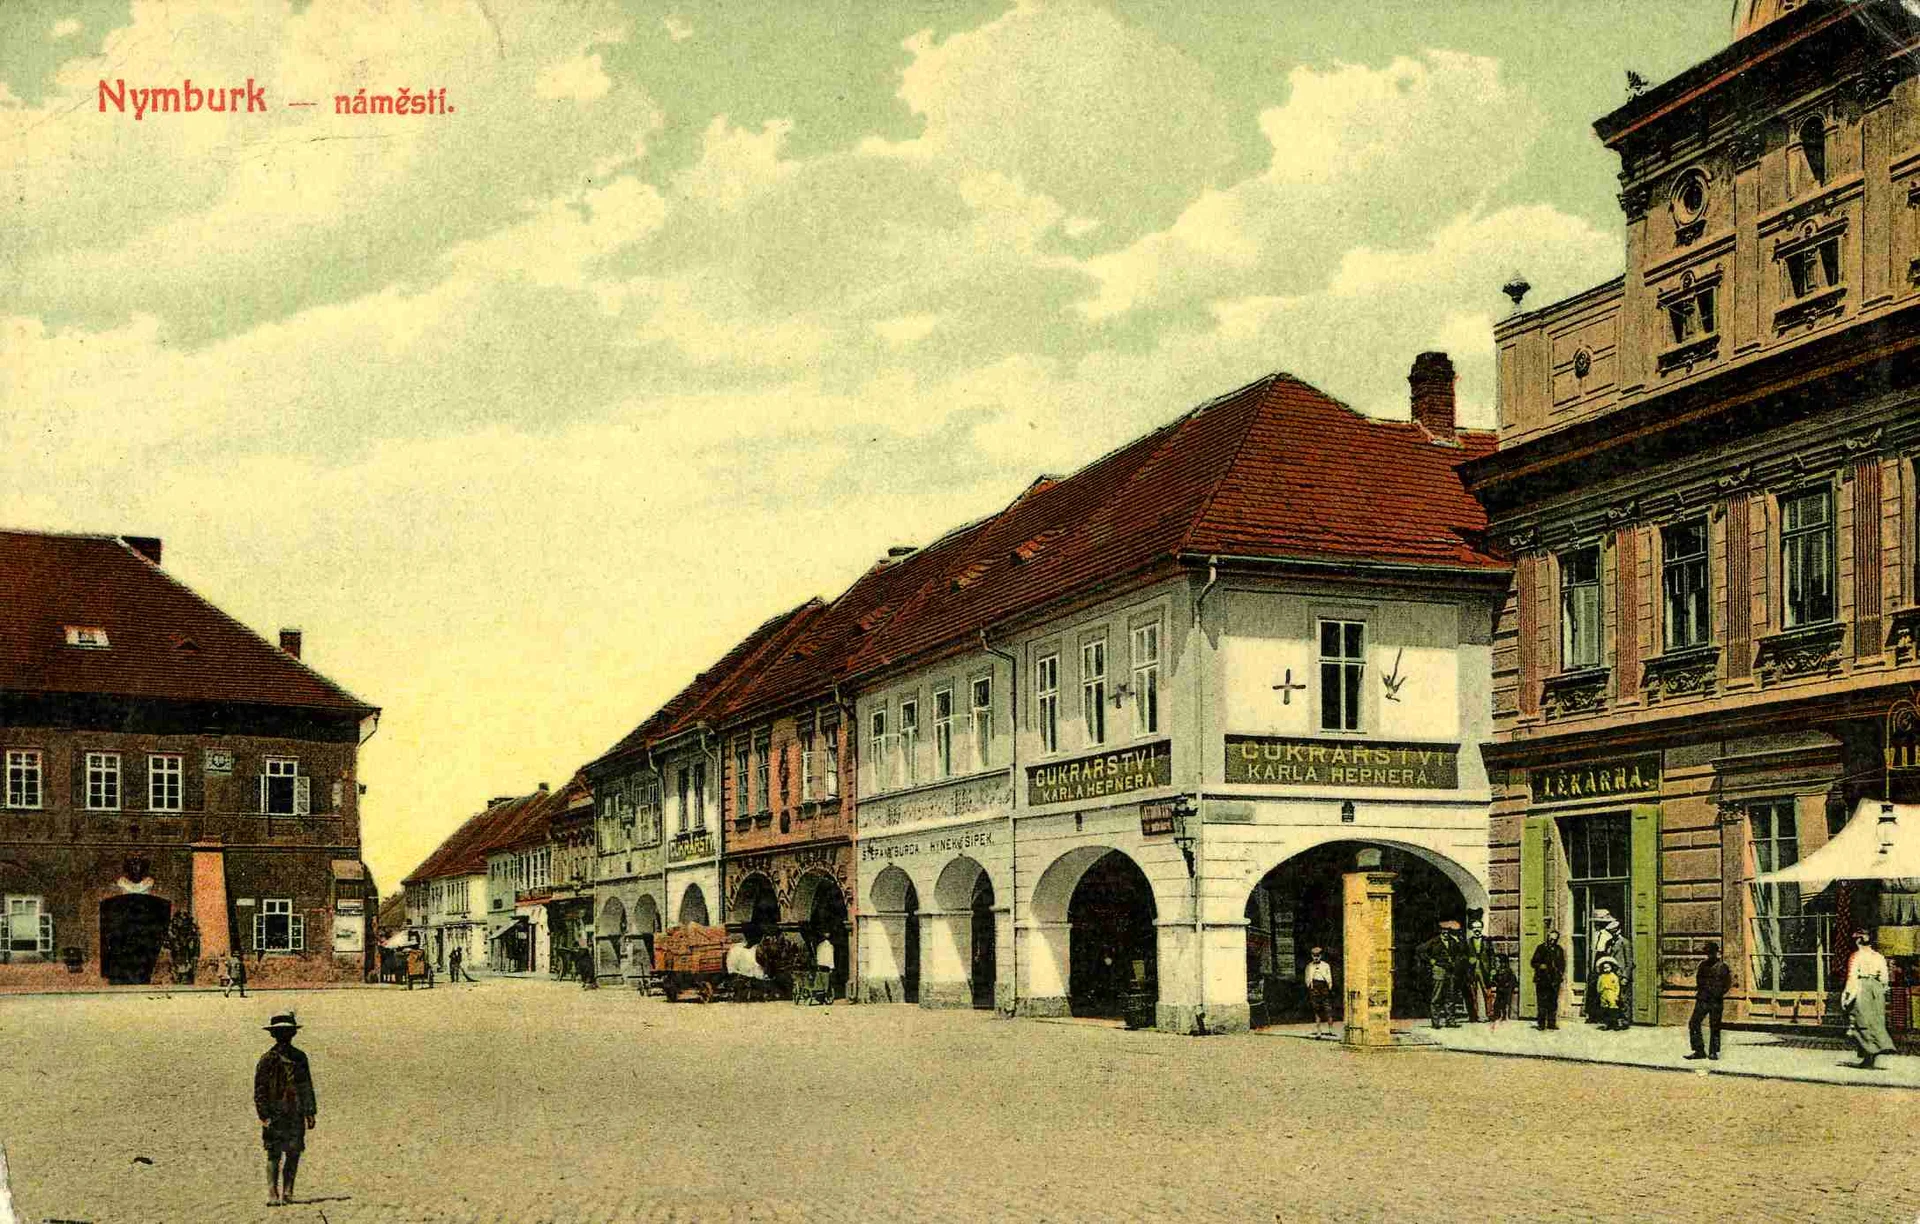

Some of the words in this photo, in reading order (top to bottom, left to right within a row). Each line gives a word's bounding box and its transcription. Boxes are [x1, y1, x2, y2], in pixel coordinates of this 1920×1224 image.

[1248, 763, 1319, 781] KARLA
[1042, 784, 1084, 803] KARLA
[1086, 772, 1156, 797] HEPNERA
